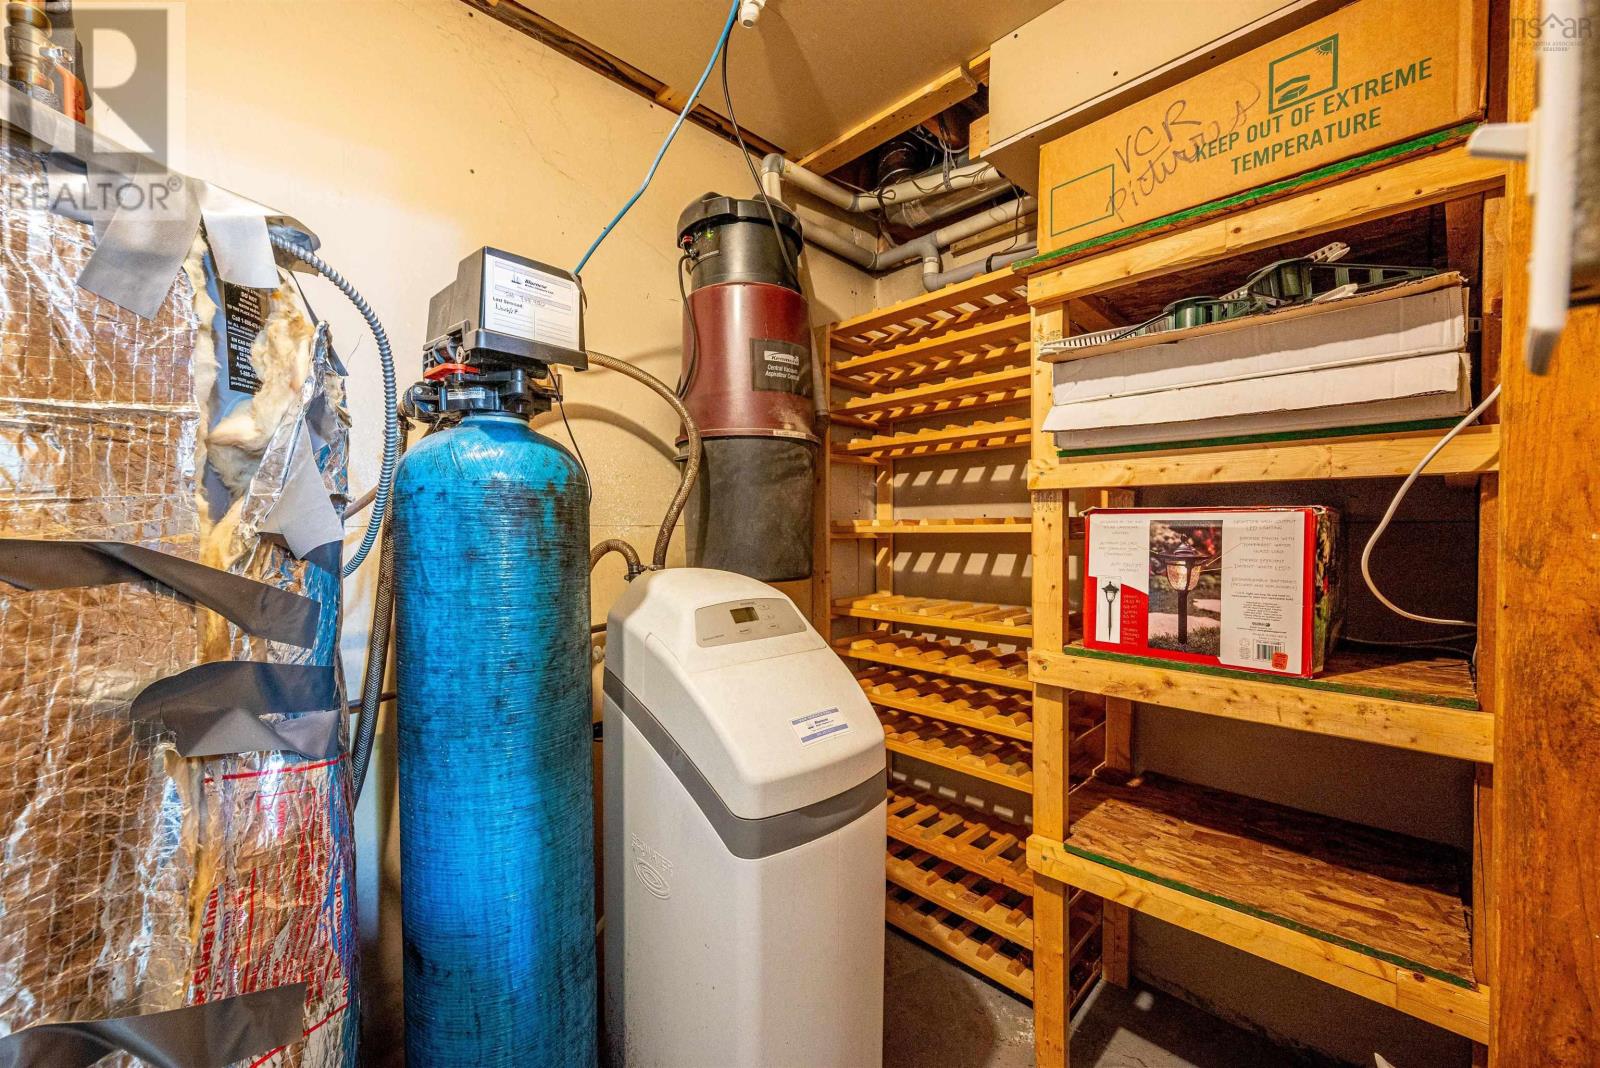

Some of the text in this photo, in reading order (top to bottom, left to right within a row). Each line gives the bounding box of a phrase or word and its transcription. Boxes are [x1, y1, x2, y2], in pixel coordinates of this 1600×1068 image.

[1115, 99, 1202, 174] VCR
[1196, 57, 1433, 162] KEEP OUT OF EXTREME
[1231, 106, 1382, 175] TEMPERATURE
